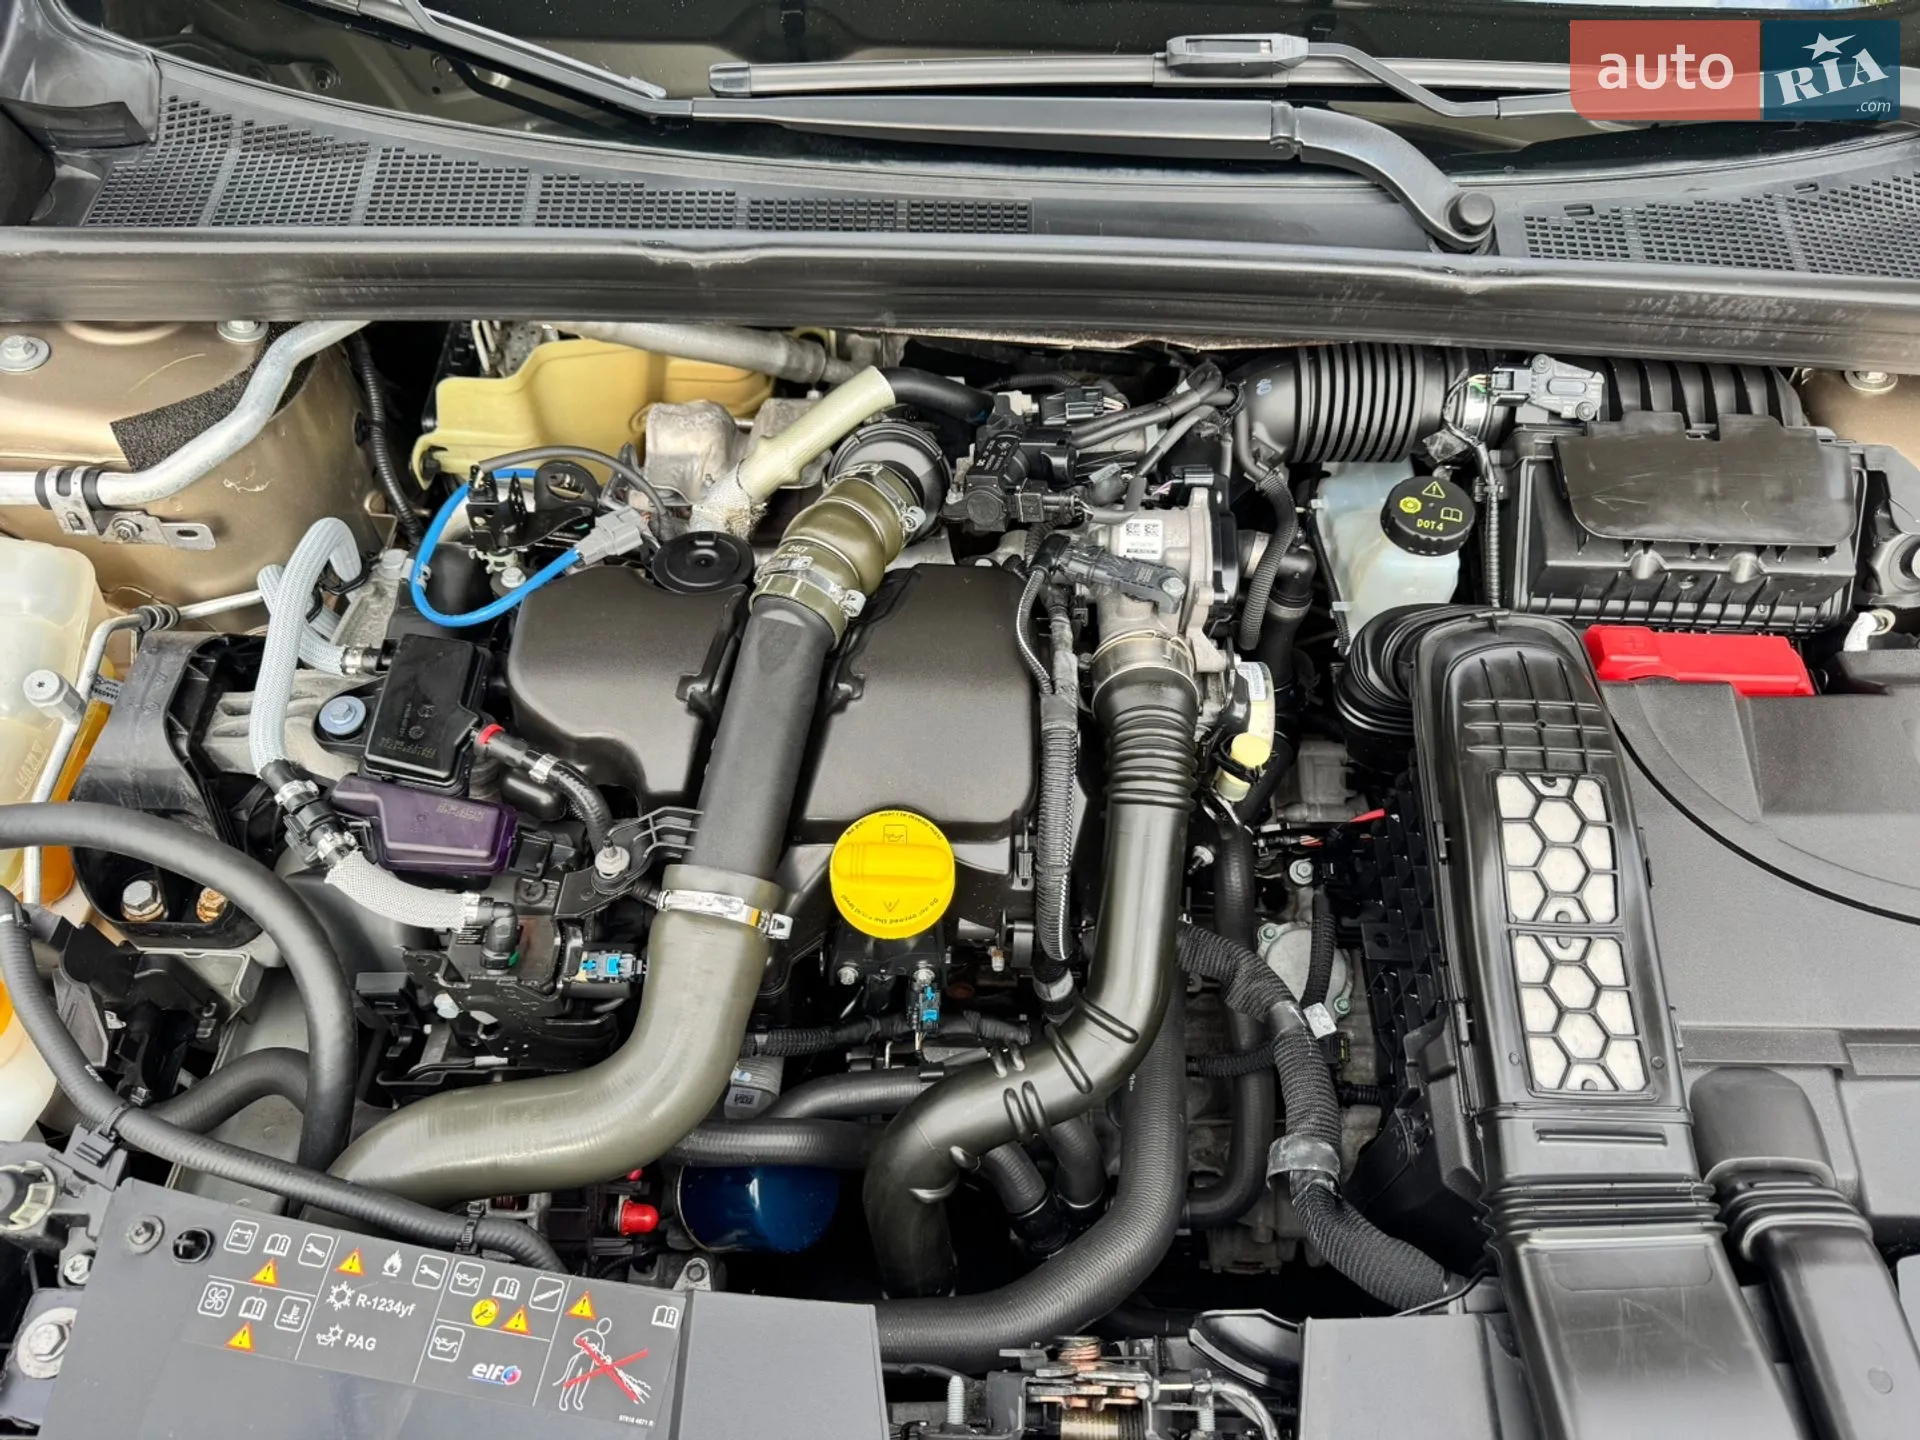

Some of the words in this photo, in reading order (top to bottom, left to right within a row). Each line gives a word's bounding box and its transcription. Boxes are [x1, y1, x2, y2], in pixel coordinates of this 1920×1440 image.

[355, 1293, 417, 1318] R-1234yf
[345, 1333, 377, 1351] PAG
[471, 1362, 505, 1381] elf
